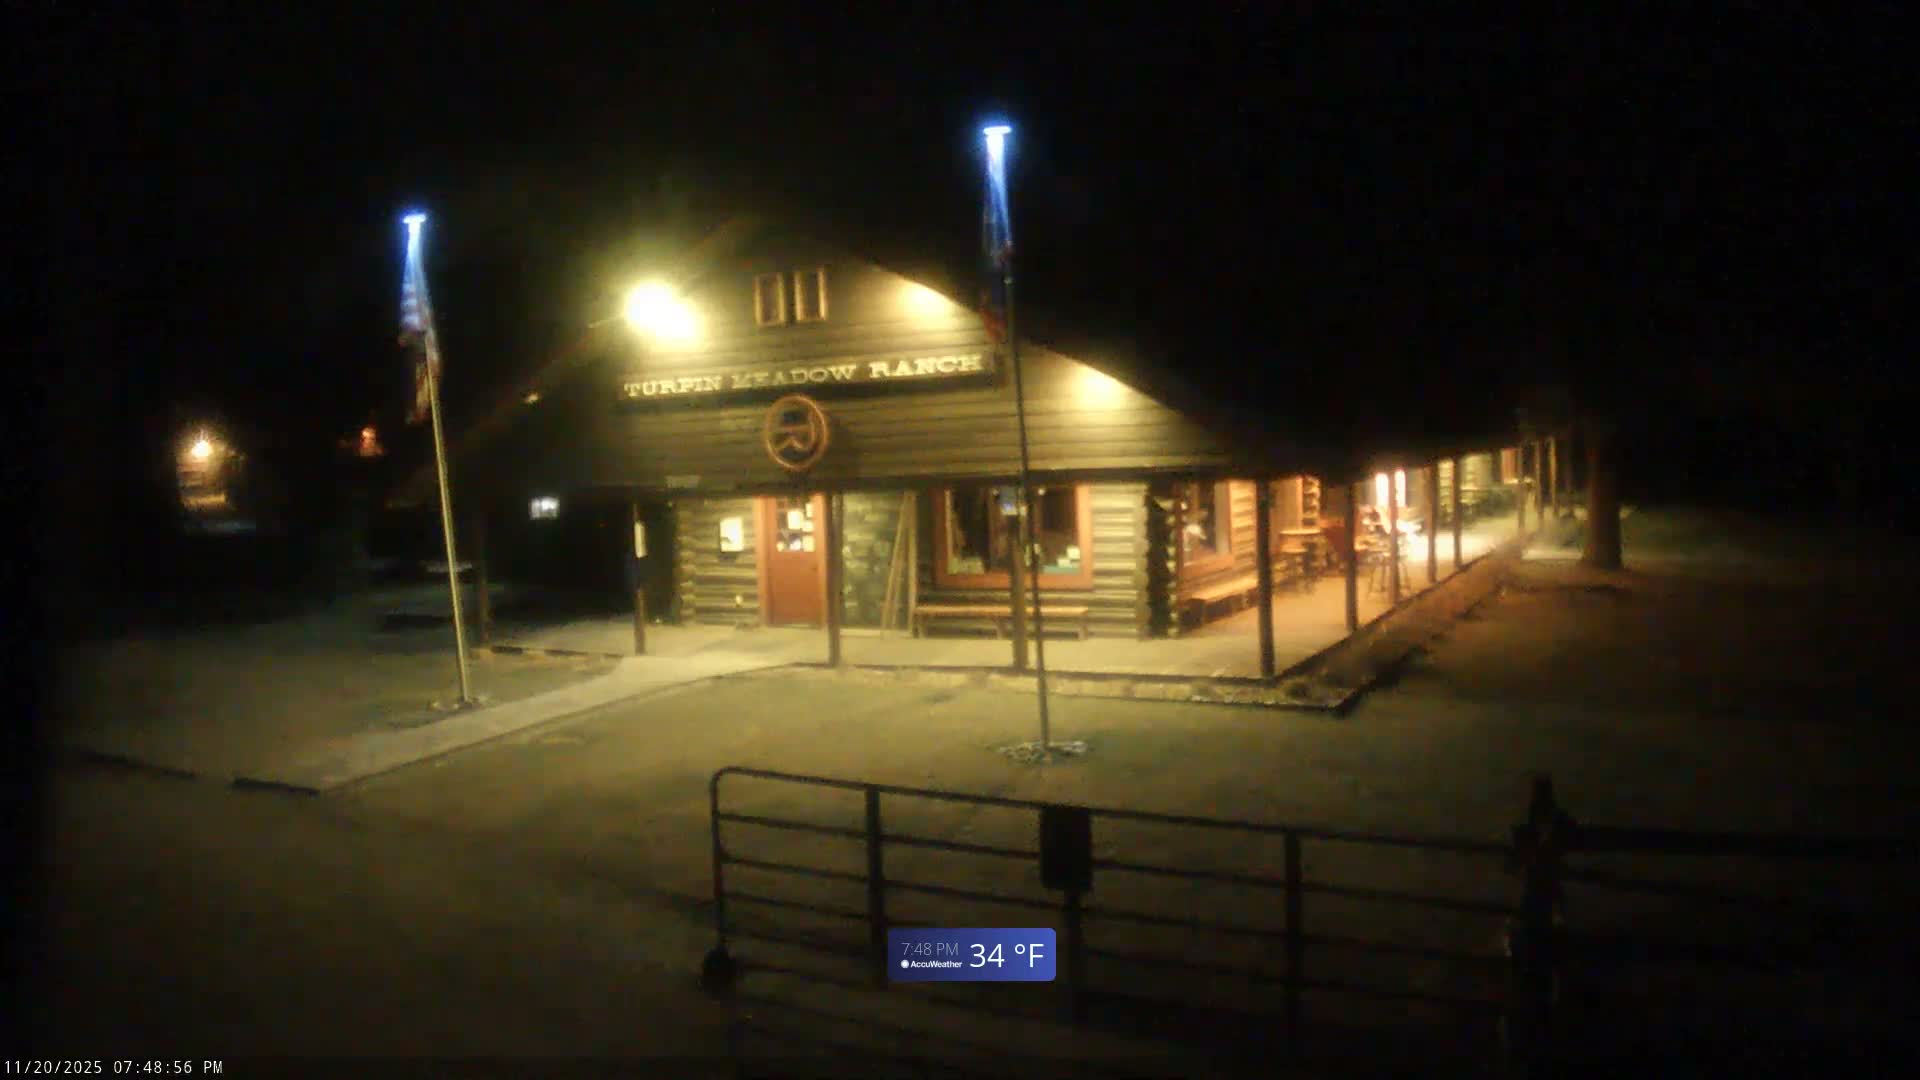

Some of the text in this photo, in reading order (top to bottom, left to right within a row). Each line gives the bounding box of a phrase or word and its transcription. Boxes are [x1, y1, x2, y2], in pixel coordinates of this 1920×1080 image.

[624, 354, 982, 397] TURPIN MEADOW RANCH
